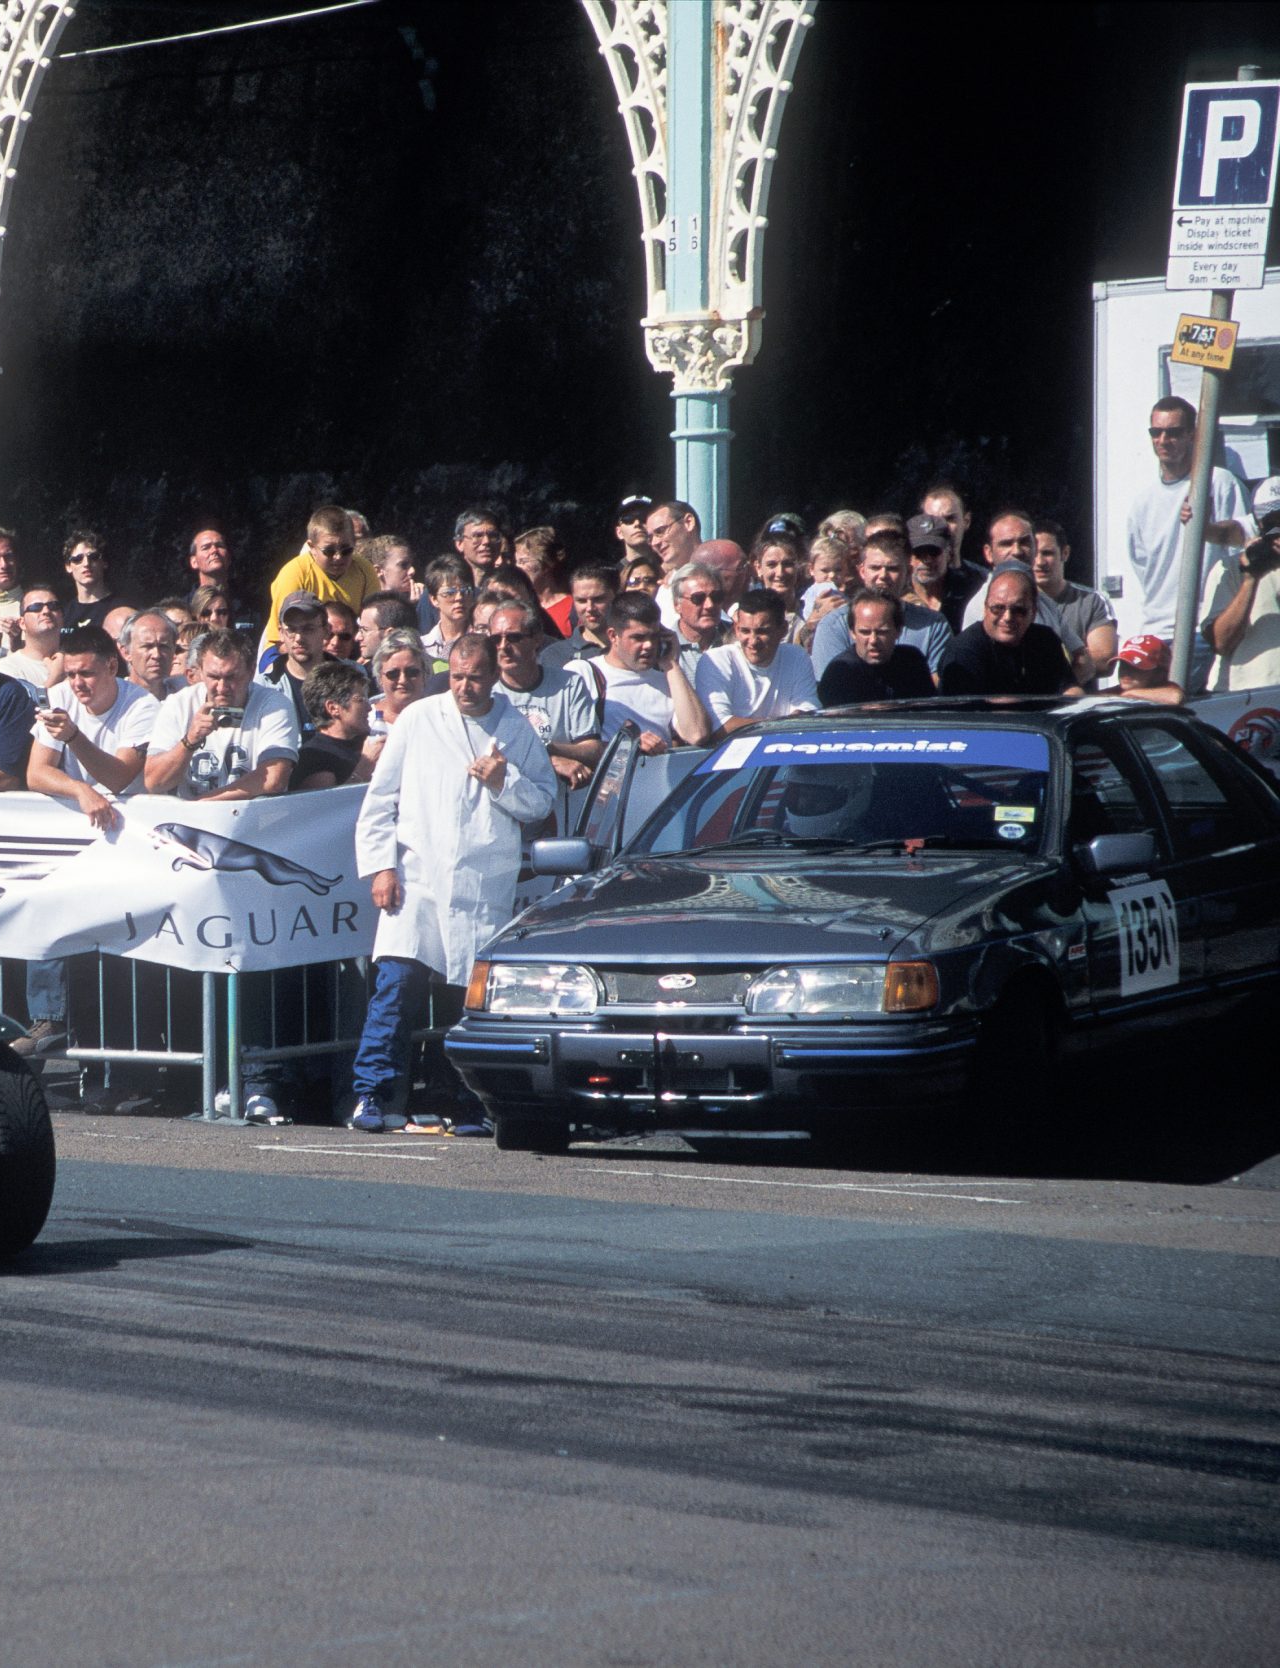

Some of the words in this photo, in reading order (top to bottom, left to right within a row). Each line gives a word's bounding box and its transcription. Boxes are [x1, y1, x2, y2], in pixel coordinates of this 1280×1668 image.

[1199, 100, 1262, 197] P
[1195, 216, 1210, 226] Pay
[1215, 217, 1224, 225] at
[1228, 214, 1266, 224] machine
[1225, 228, 1252, 237] ticket
[1177, 243, 1203, 251] inside
[1208, 241, 1259, 250] windscreen
[1193, 261, 1218, 273] Every
[1222, 262, 1238, 272] day
[1189, 274, 1208, 284] 9am
[1221, 274, 1240, 284] 6pm
[1181, 348, 1189, 356] At
[764, 740, 968, 754] Aquamist
[126, 901, 358, 949] JAGUAR
